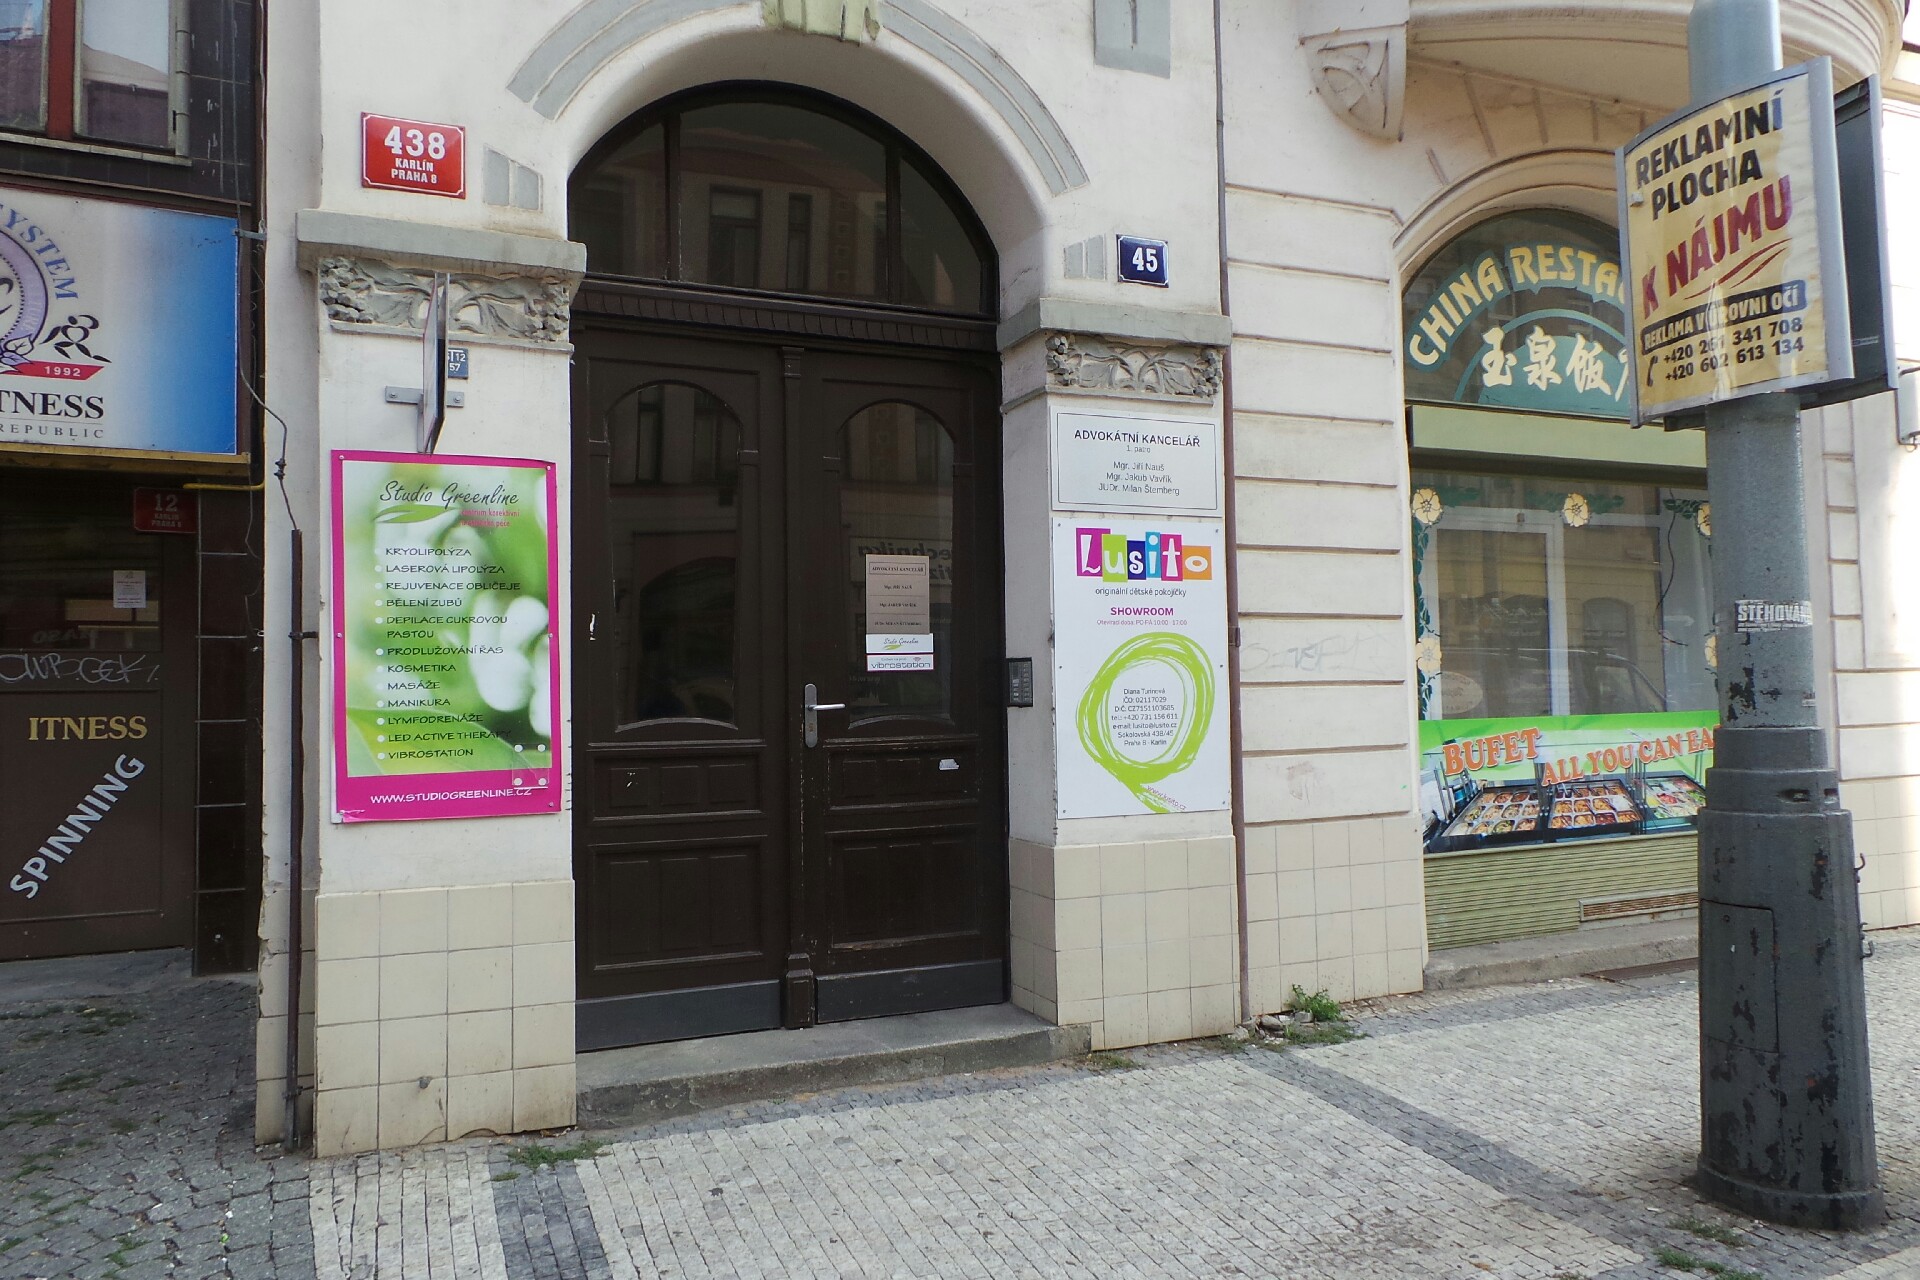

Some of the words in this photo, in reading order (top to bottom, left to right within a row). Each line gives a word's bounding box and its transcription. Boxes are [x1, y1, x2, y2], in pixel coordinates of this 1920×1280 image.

[384, 126, 446, 160] 438
[1636, 88, 1784, 189] REKLAMNÍ
[395, 158, 434, 172] KARLÍN
[391, 168, 428, 183] PRAHA
[431, 174, 437, 184] 8
[1652, 149, 1763, 221] PLOCHA
[0, 203, 79, 300] YSTEM
[1642, 265, 1659, 320] K
[1666, 174, 1793, 297] NÁJMU
[1132, 247, 1158, 273] 45
[1410, 257, 1504, 366] CHINA
[1510, 245, 1625, 304] RESTA
[1645, 316, 1694, 350] REKLAMA
[1771, 284, 1799, 310] OČÍ
[1664, 345, 1694, 364] +420
[1732, 325, 1762, 345] 341
[1768, 317, 1803, 337] 708
[1665, 363, 1694, 381] +420
[1701, 353, 1728, 372] 602
[1736, 345, 1764, 363] 613
[1772, 337, 1804, 356] 134
[44, 365, 81, 378] 1992
[1074, 429, 1139, 444] ADVOKÁTNÍ
[1142, 433, 1200, 447] KANCELÁŘ
[1113, 461, 1130, 470] Mgr.
[1107, 472, 1123, 482] Mgr.
[1125, 473, 1148, 481] Jakub
[379, 480, 433, 502] Studio
[441, 482, 520, 510] Greenline
[1098, 483, 1120, 492] JUDr.
[1122, 484, 1142, 493] Milan
[155, 493, 178, 512] 12
[385, 547, 472, 556] KRYOLIPOLÝZA
[1080, 534, 1209, 578] Lusito
[386, 564, 450, 573] LASEROVÁ
[452, 564, 505, 573] LIPOLÝZA
[386, 582, 464, 590] REJUVENACE
[466, 581, 521, 590] OBLIČEJE
[1095, 588, 1128, 597] originální
[1130, 588, 1153, 596] dětské
[1154, 589, 1187, 597] pokojíčky
[387, 598, 429, 607] BĚLENÍ
[431, 598, 462, 607] ZUBŮ
[1110, 607, 1174, 616] SHOWROOM
[387, 616, 444, 624] DEPILACE
[446, 616, 508, 624] CUKROVOU
[387, 630, 434, 638] PASTOU
[387, 645, 477, 656] PRODLUŽOVÁNÍ
[387, 664, 456, 672] KOSMETIKA
[387, 680, 440, 690] MASÁŽE
[388, 699, 450, 707] MANIKURA
[388, 713, 484, 725] LYMFODRENÁŽE
[28, 716, 148, 741] ITNESS
[388, 734, 411, 742] LED
[414, 732, 455, 741] ACTIVE
[457, 731, 511, 740] THERAPY
[388, 749, 474, 759] VIBROSTATION
[1443, 727, 1541, 777] BUFET
[1541, 756, 1585, 787] ALL
[1586, 743, 1634, 776] YOU
[1638, 733, 1683, 764] CAN
[1686, 724, 1720, 754] EA
[370, 788, 532, 803] WWW.STUDIOGREENLINE.CZ
[10, 753, 145, 899] SPINNING
